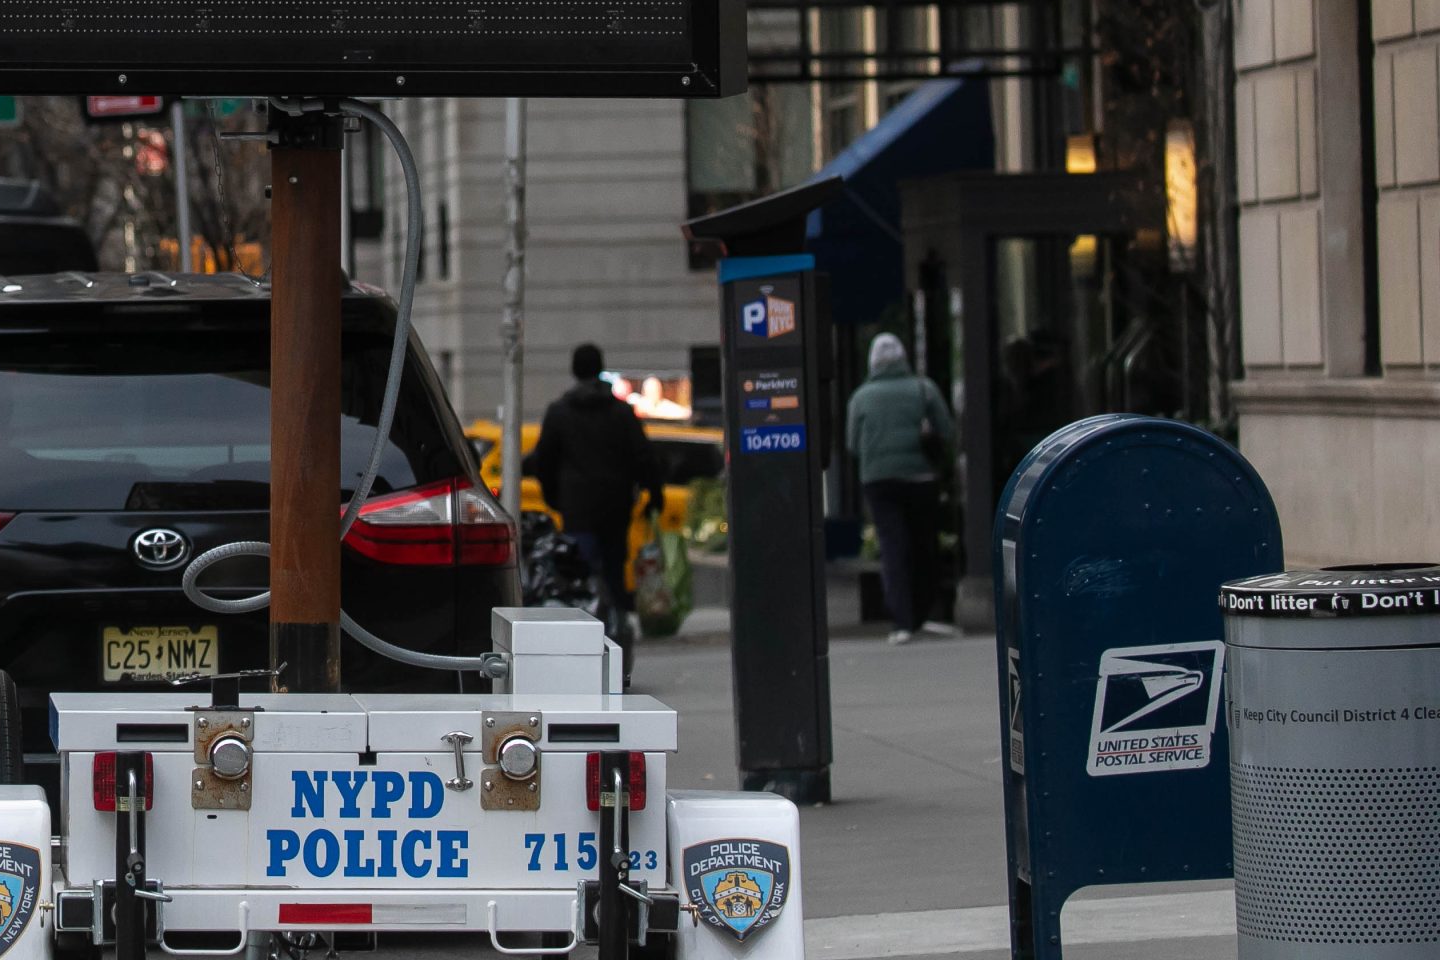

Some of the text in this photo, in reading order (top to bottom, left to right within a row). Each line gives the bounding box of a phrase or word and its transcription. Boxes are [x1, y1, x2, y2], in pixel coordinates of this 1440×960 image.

[743, 301, 765, 332] P
[755, 378, 798, 390] ParkNYC
[746, 432, 801, 450] 104708
[1229, 593, 1264, 610] Don't
[1270, 594, 1317, 610] litter
[1362, 591, 1424, 609] Don't
[107, 639, 212, 670] C25 NMZ
[1243, 707, 1264, 725] Keep
[1266, 709, 1287, 725] City
[1290, 708, 1339, 723] Council
[1343, 708, 1397, 722] District
[1400, 707, 1410, 720] 4
[1097, 733, 1199, 753] UNITED STATES
[1095, 753, 1146, 768] POSTAL
[291, 770, 445, 819] NYPD
[266, 828, 468, 878] POLICE
[524, 832, 658, 870] 715 23
[710, 842, 761, 857] POLICE
[690, 854, 782, 876] DEPARTMENT
[3, 886, 35, 943] NEW YORK
